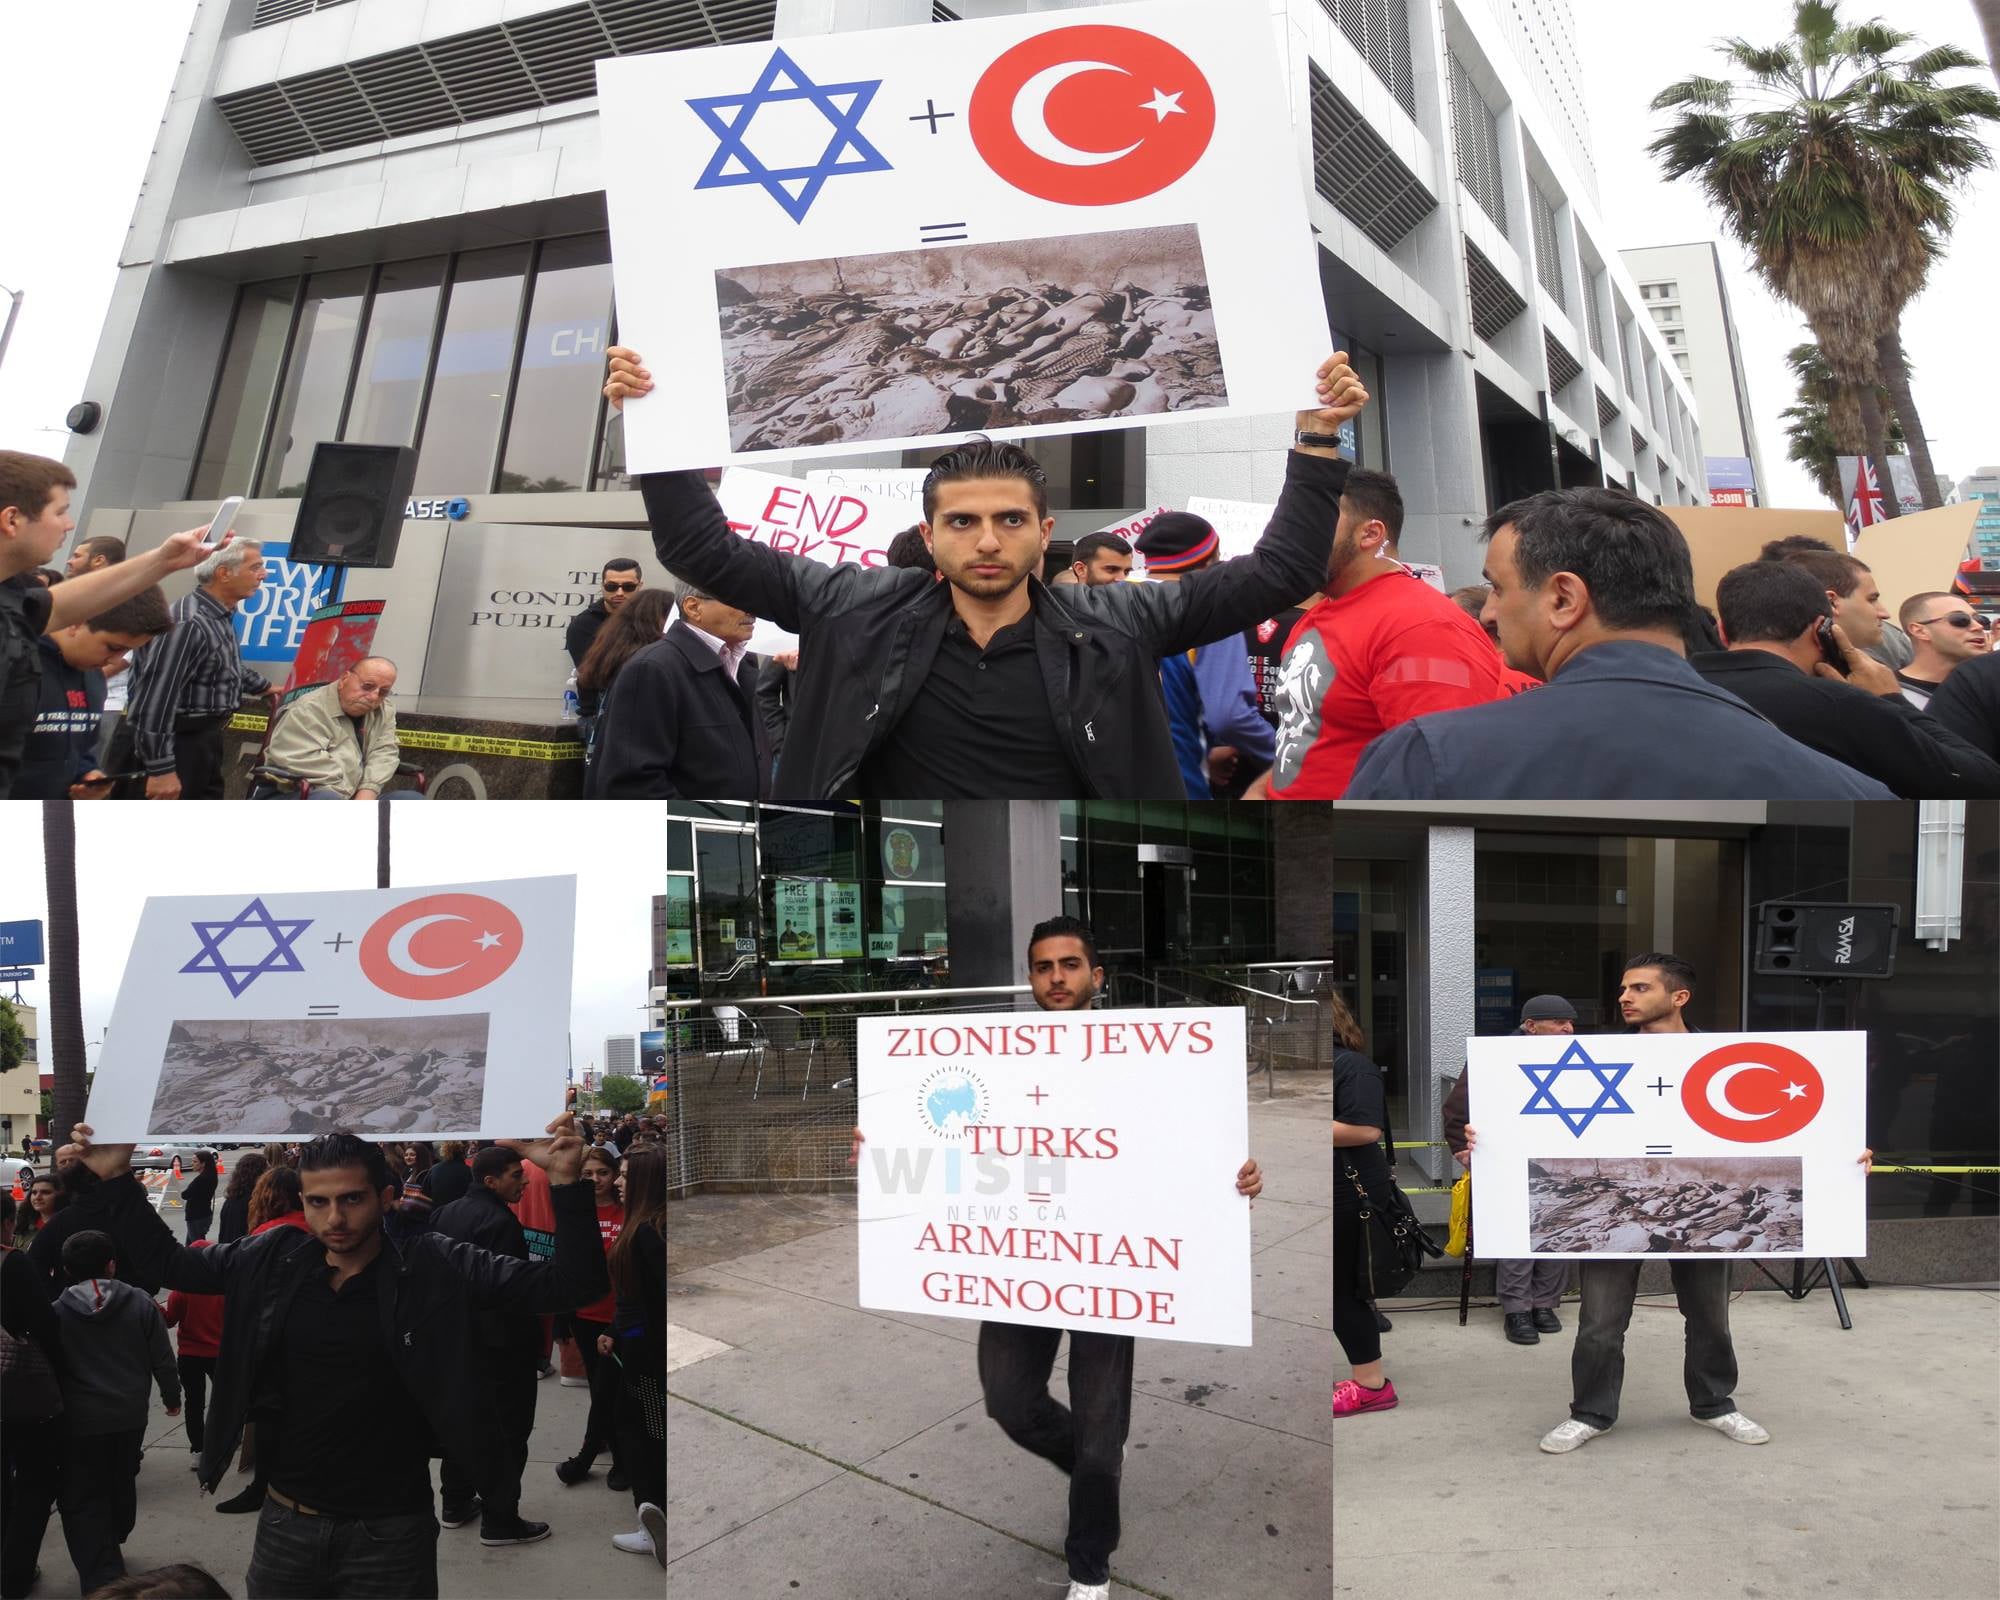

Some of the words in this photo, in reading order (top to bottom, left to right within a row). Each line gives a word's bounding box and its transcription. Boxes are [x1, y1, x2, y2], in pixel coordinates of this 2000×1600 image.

[551, 327, 604, 356] CH
[1336, 428, 1355, 451] SE
[762, 486, 868, 539] END
[784, 884, 808, 897] FREE
[871, 940, 894, 951] SALAD
[1835, 916, 1855, 963] RAMSA
[887, 1024, 1067, 1057] ZIONIST
[1080, 1020, 1214, 1062] JEWS
[964, 1124, 1119, 1160] TURKS
[915, 1222, 1184, 1271] ARMENIAN
[923, 1272, 1177, 1325] GENOCIDE
